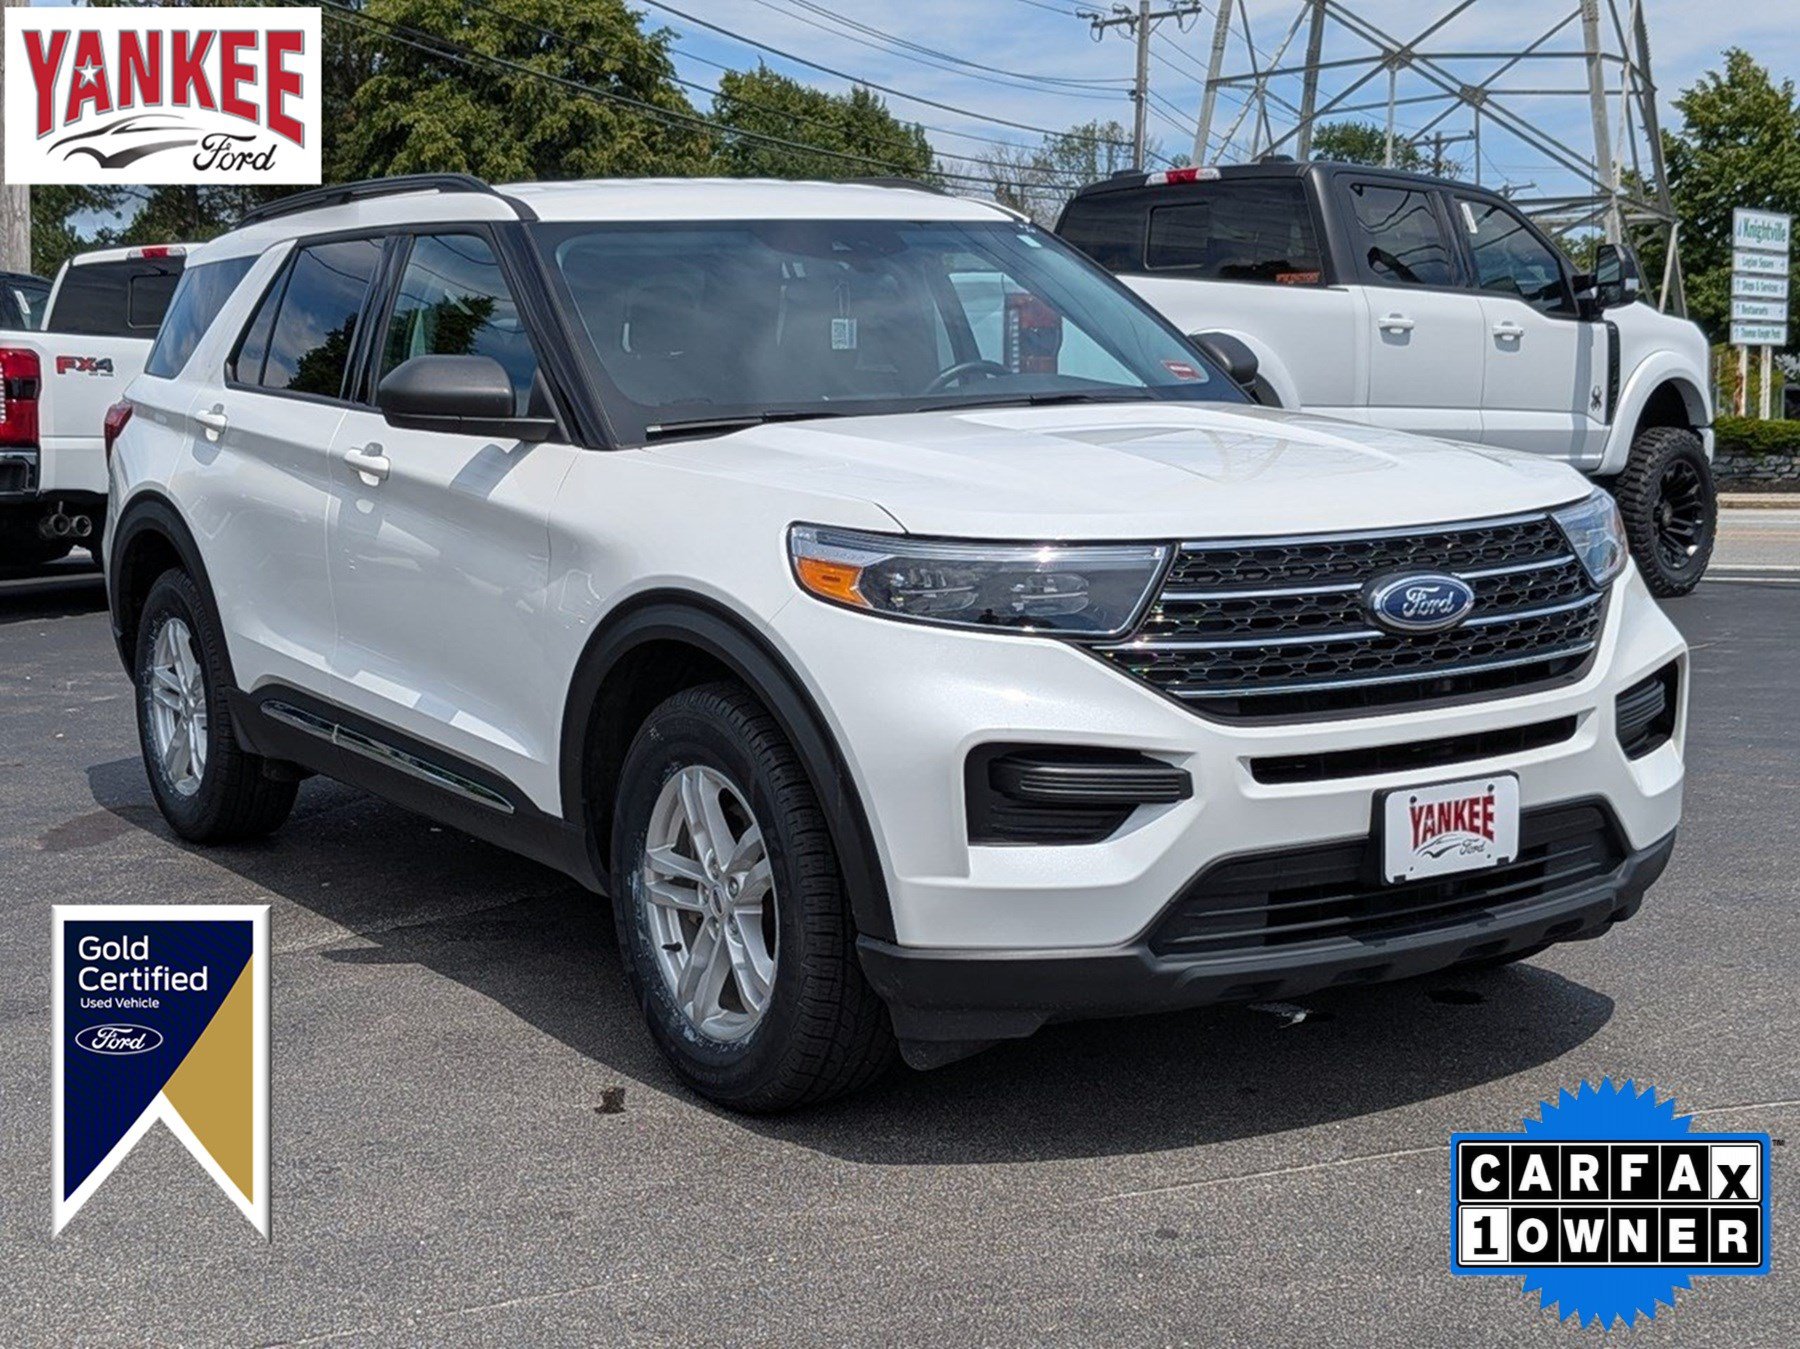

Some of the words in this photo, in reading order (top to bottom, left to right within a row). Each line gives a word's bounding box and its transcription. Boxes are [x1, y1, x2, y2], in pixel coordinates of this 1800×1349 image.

[1743, 217, 1786, 243] Knightville
[56, 355, 114, 374] FX4
[1402, 586, 1454, 617] Ford
[1409, 795, 1494, 851] YANKEE
[1460, 838, 1486, 855] Ford
